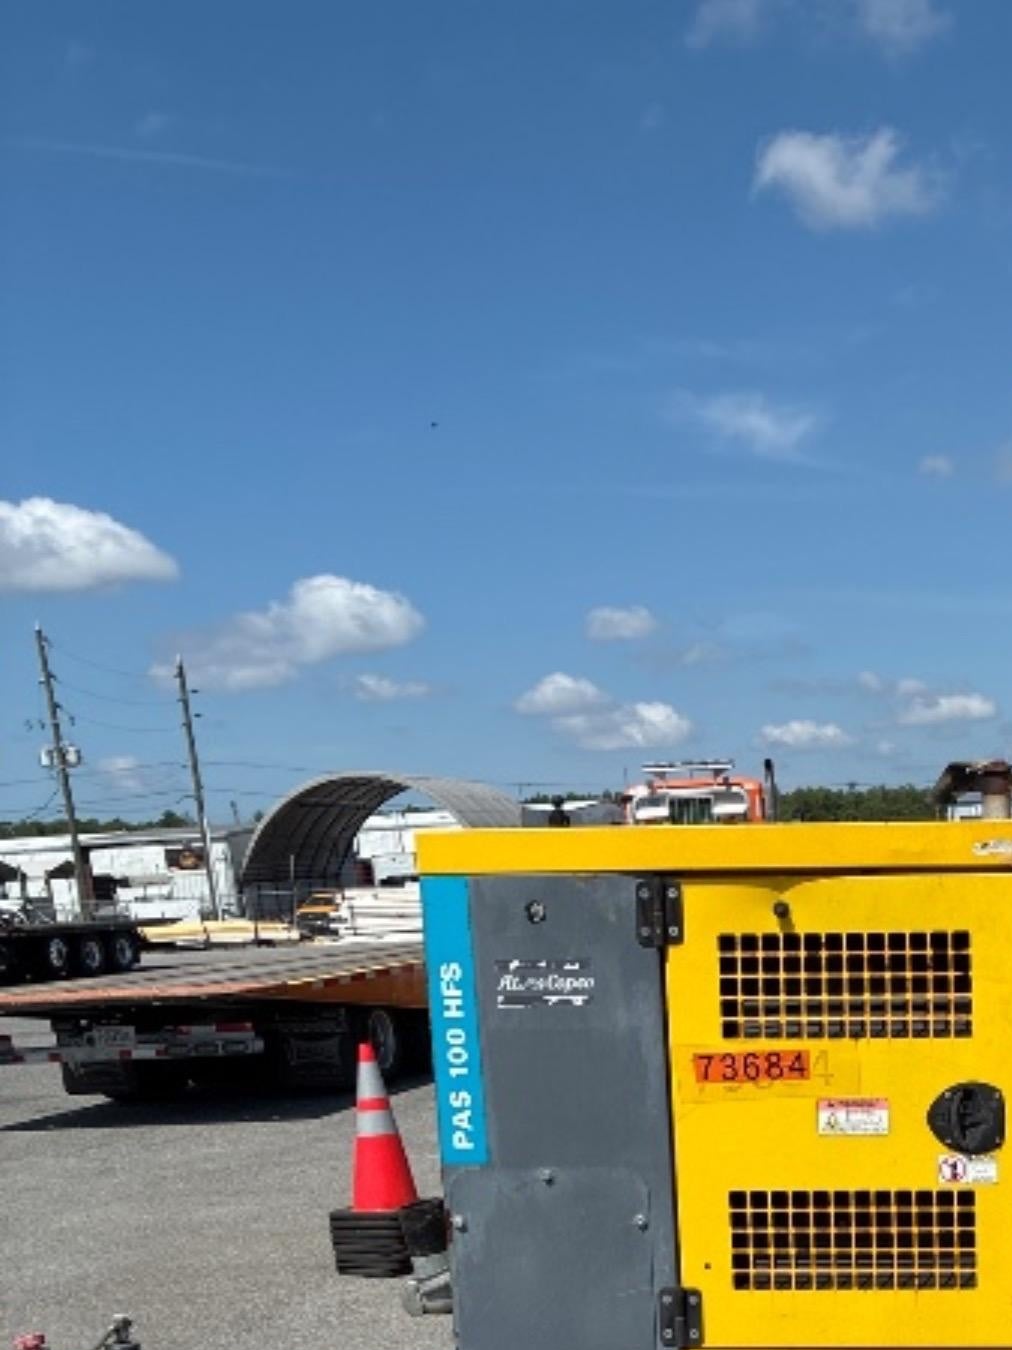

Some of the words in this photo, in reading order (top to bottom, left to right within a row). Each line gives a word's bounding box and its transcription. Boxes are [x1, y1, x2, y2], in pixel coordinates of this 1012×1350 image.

[440, 962, 465, 1018] HFS
[446, 1028, 469, 1078] 100
[697, 1052, 807, 1081] 73684
[449, 1091, 475, 1150] PAS
